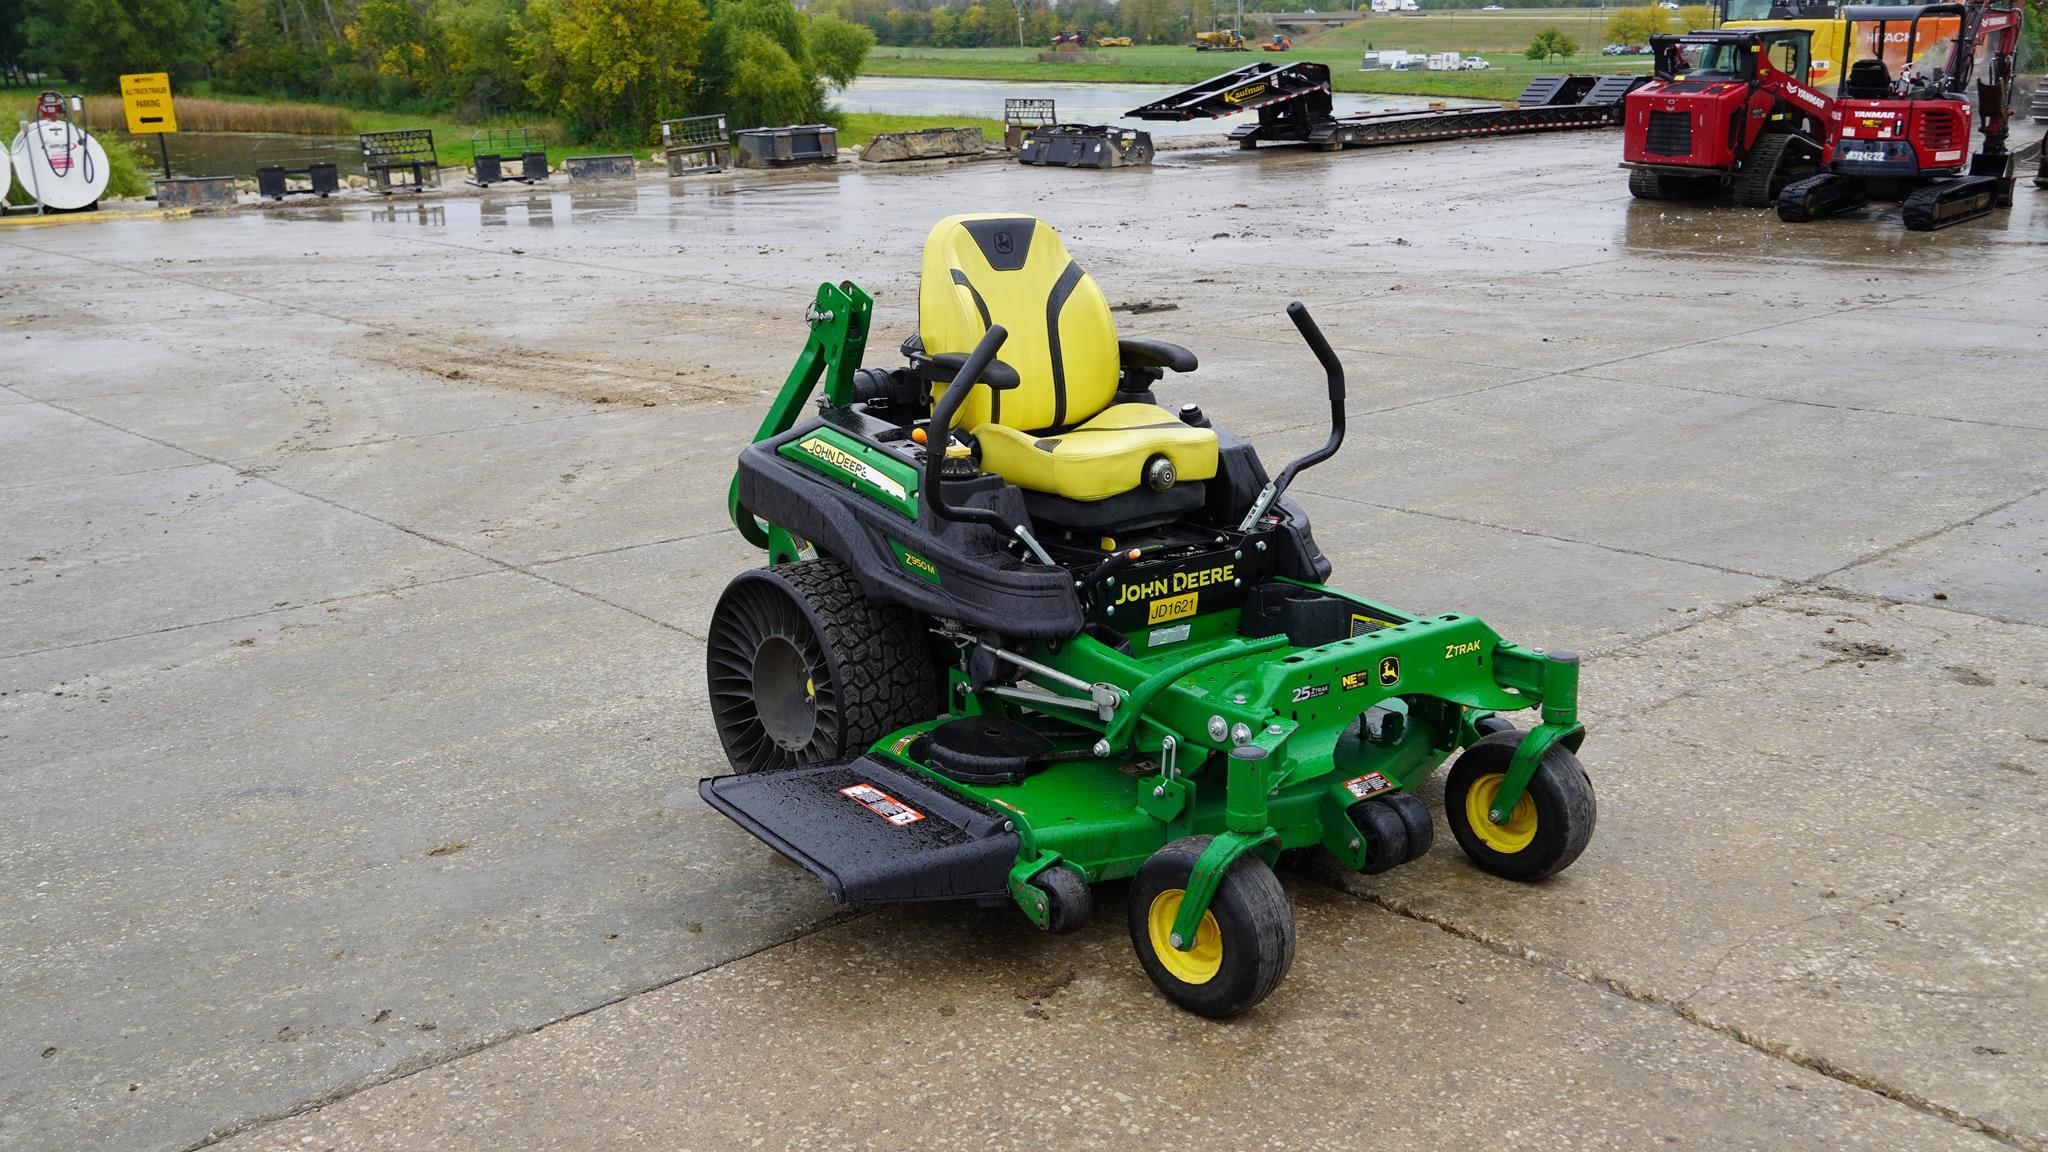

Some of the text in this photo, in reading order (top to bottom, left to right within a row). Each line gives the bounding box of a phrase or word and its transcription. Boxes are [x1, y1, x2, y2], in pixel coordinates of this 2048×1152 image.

[136, 99, 161, 108] PARKING
[1224, 84, 1265, 103] Kaufman
[1797, 87, 1825, 109] YANMAR
[1854, 111, 1896, 119] YANMAR
[809, 441, 836, 464] JOHN
[904, 552, 935, 575] Z950M
[1115, 564, 1235, 605] JOHN DEERE
[1151, 598, 1194, 620] JD1621
[1445, 639, 1481, 659] ZTRAK
[1342, 674, 1357, 687] NE
[1291, 685, 1311, 703] 25
